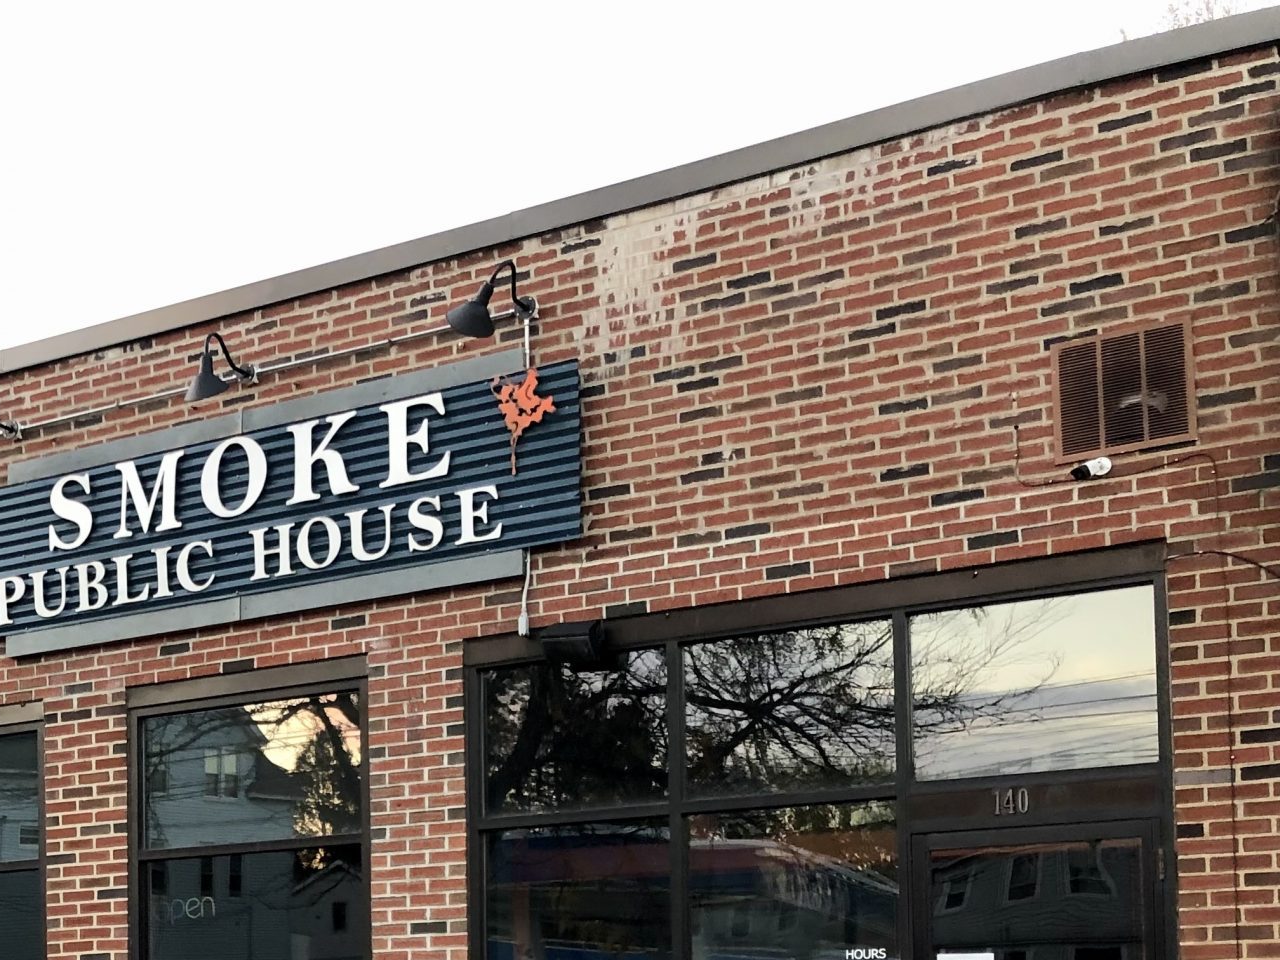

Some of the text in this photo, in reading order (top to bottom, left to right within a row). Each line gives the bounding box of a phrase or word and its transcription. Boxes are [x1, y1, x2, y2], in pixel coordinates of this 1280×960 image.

[48, 393, 451, 552] SMOKE
[249, 484, 503, 581] HOUSE
[993, 788, 1029, 815] 140
[845, 948, 887, 960] HOURS
